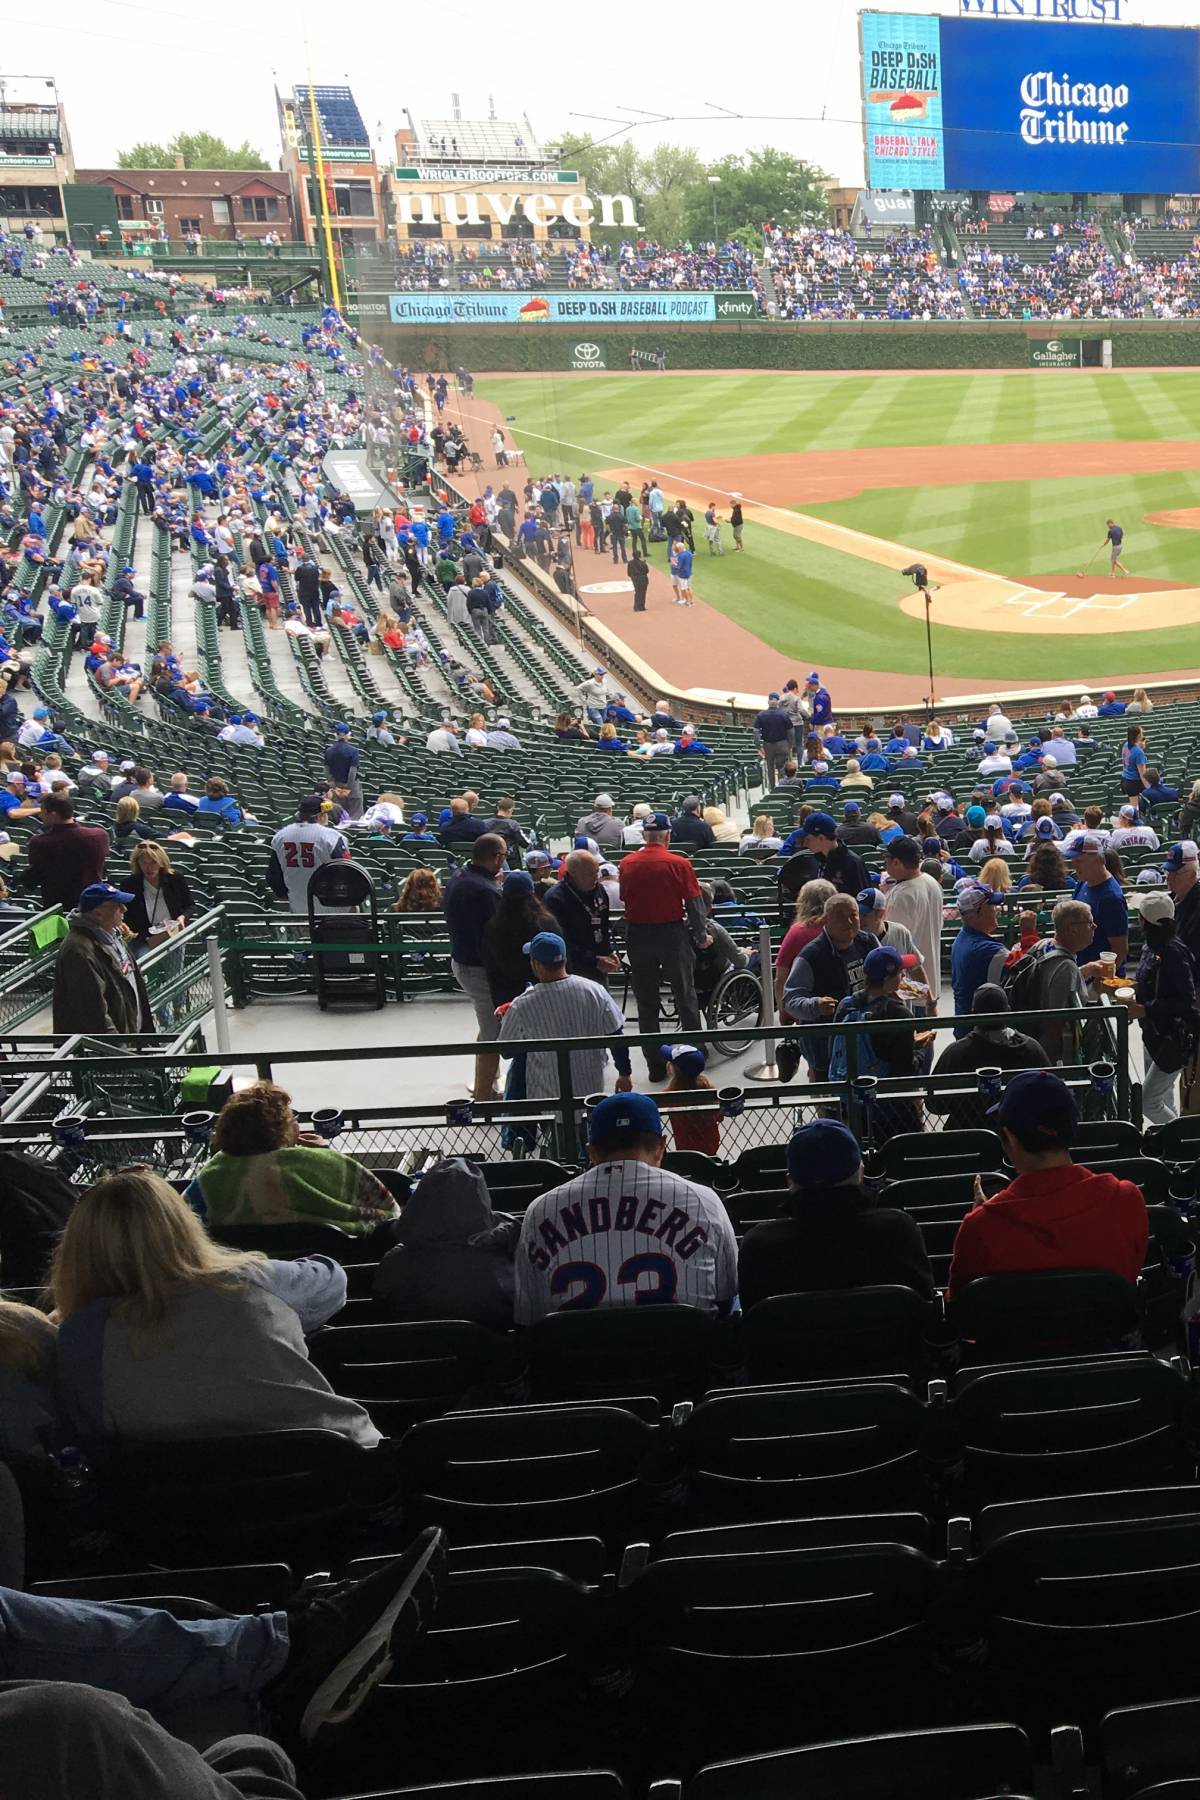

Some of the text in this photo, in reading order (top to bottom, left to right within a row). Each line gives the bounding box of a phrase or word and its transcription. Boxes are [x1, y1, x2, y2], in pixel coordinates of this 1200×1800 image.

[871, 50, 903, 68] DEEP
[870, 68, 938, 90] BASEBALL
[1020, 71, 1129, 113] Chicago
[1020, 108, 1129, 145] Tribune
[874, 135, 914, 145] BASEBALL
[416, 168, 559, 182] WRIGLEYROOFTOPS.COM
[397, 192, 640, 227] nuveen
[396, 301, 509, 319] Chicago Tribune
[557, 301, 586, 315] DEEP
[620, 301, 667, 315] BASEBALL
[670, 301, 709, 315] PODCAST
[717, 302, 753, 315] xfinity
[1033, 352, 1077, 362] Gallagher
[78, 595, 92, 607] 14
[283, 842, 315, 868] 25
[527, 1195, 709, 1272] SANDBERG
[551, 1251, 679, 1312] 23
